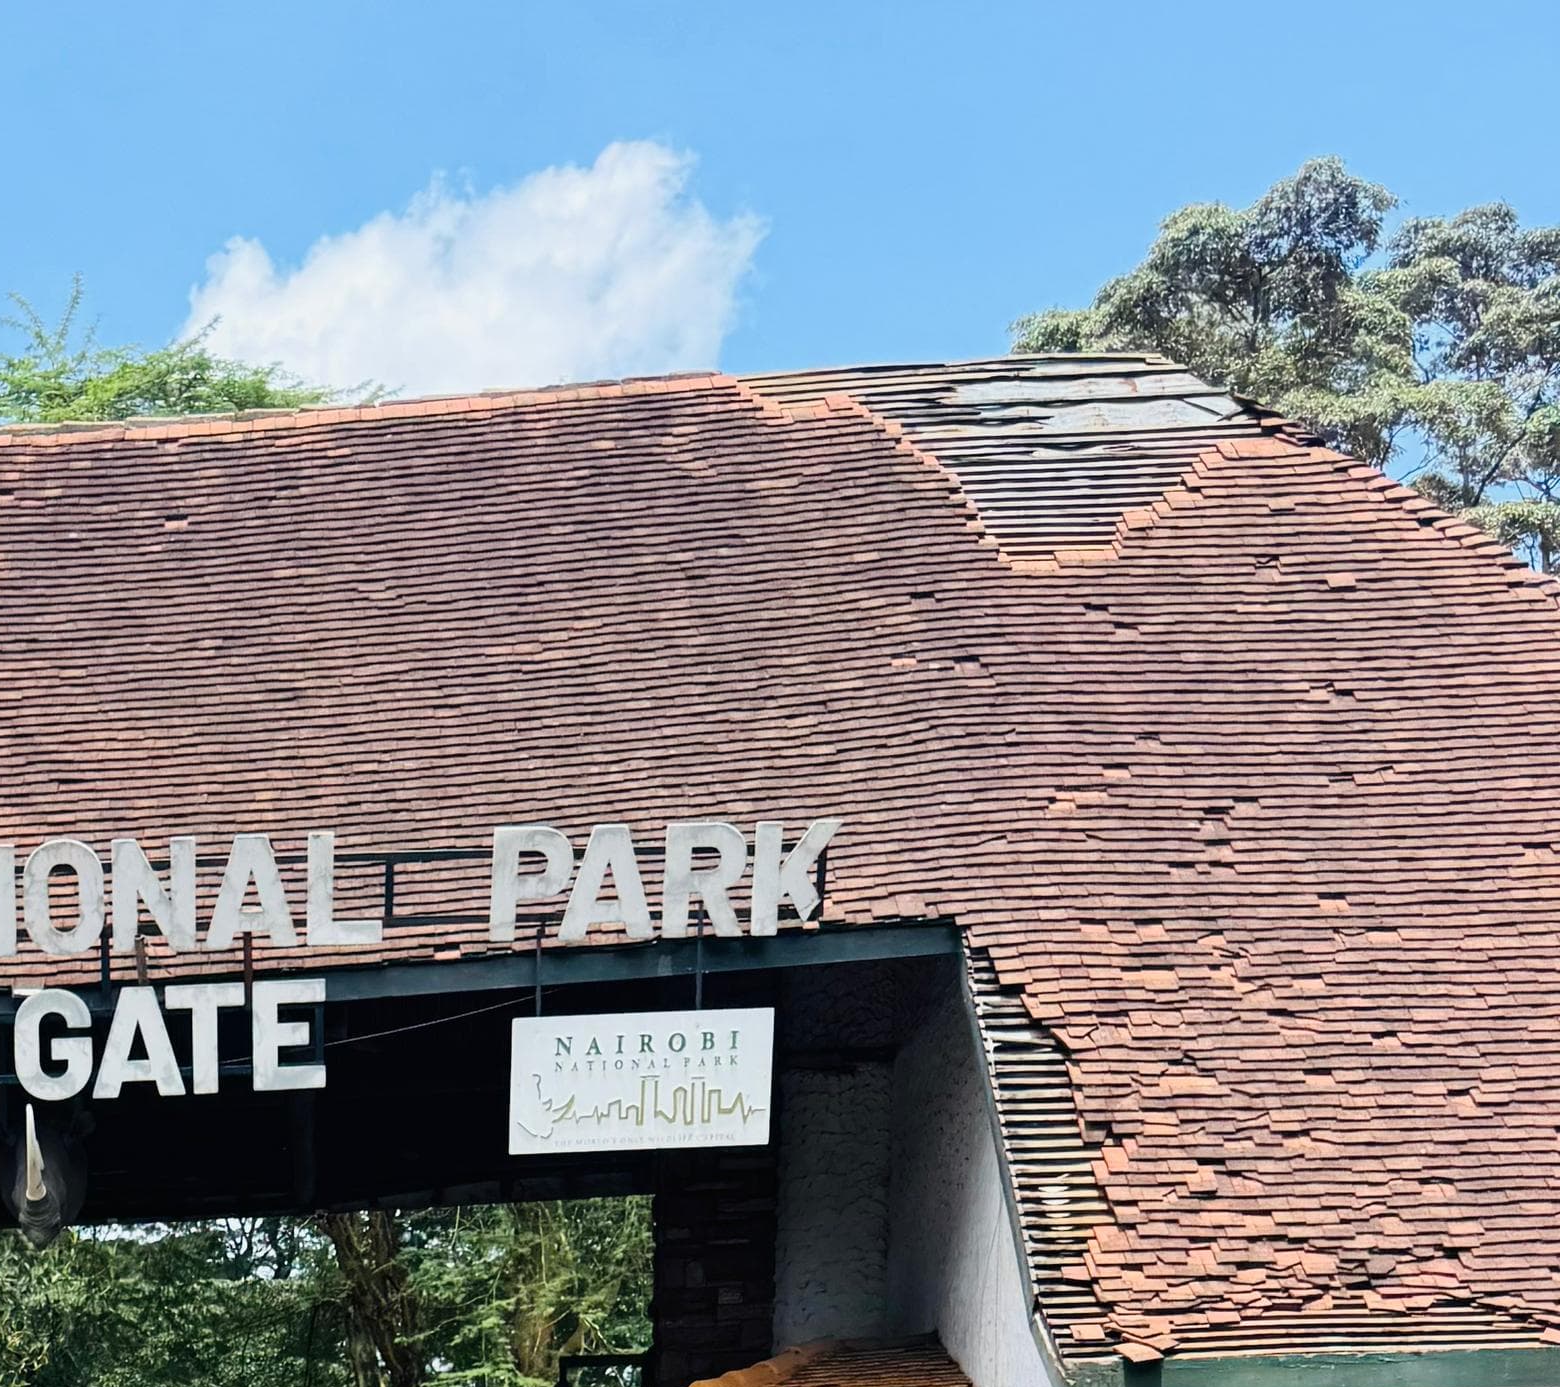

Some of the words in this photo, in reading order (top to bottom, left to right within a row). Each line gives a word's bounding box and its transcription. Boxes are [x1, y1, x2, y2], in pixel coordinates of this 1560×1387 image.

[489, 818, 844, 943] PARK
[12, 977, 328, 1102] GATE
[553, 1057, 672, 1073] NATIONAL
[683, 1054, 739, 1069] PARK
[554, 1030, 740, 1057] NAIROBI
